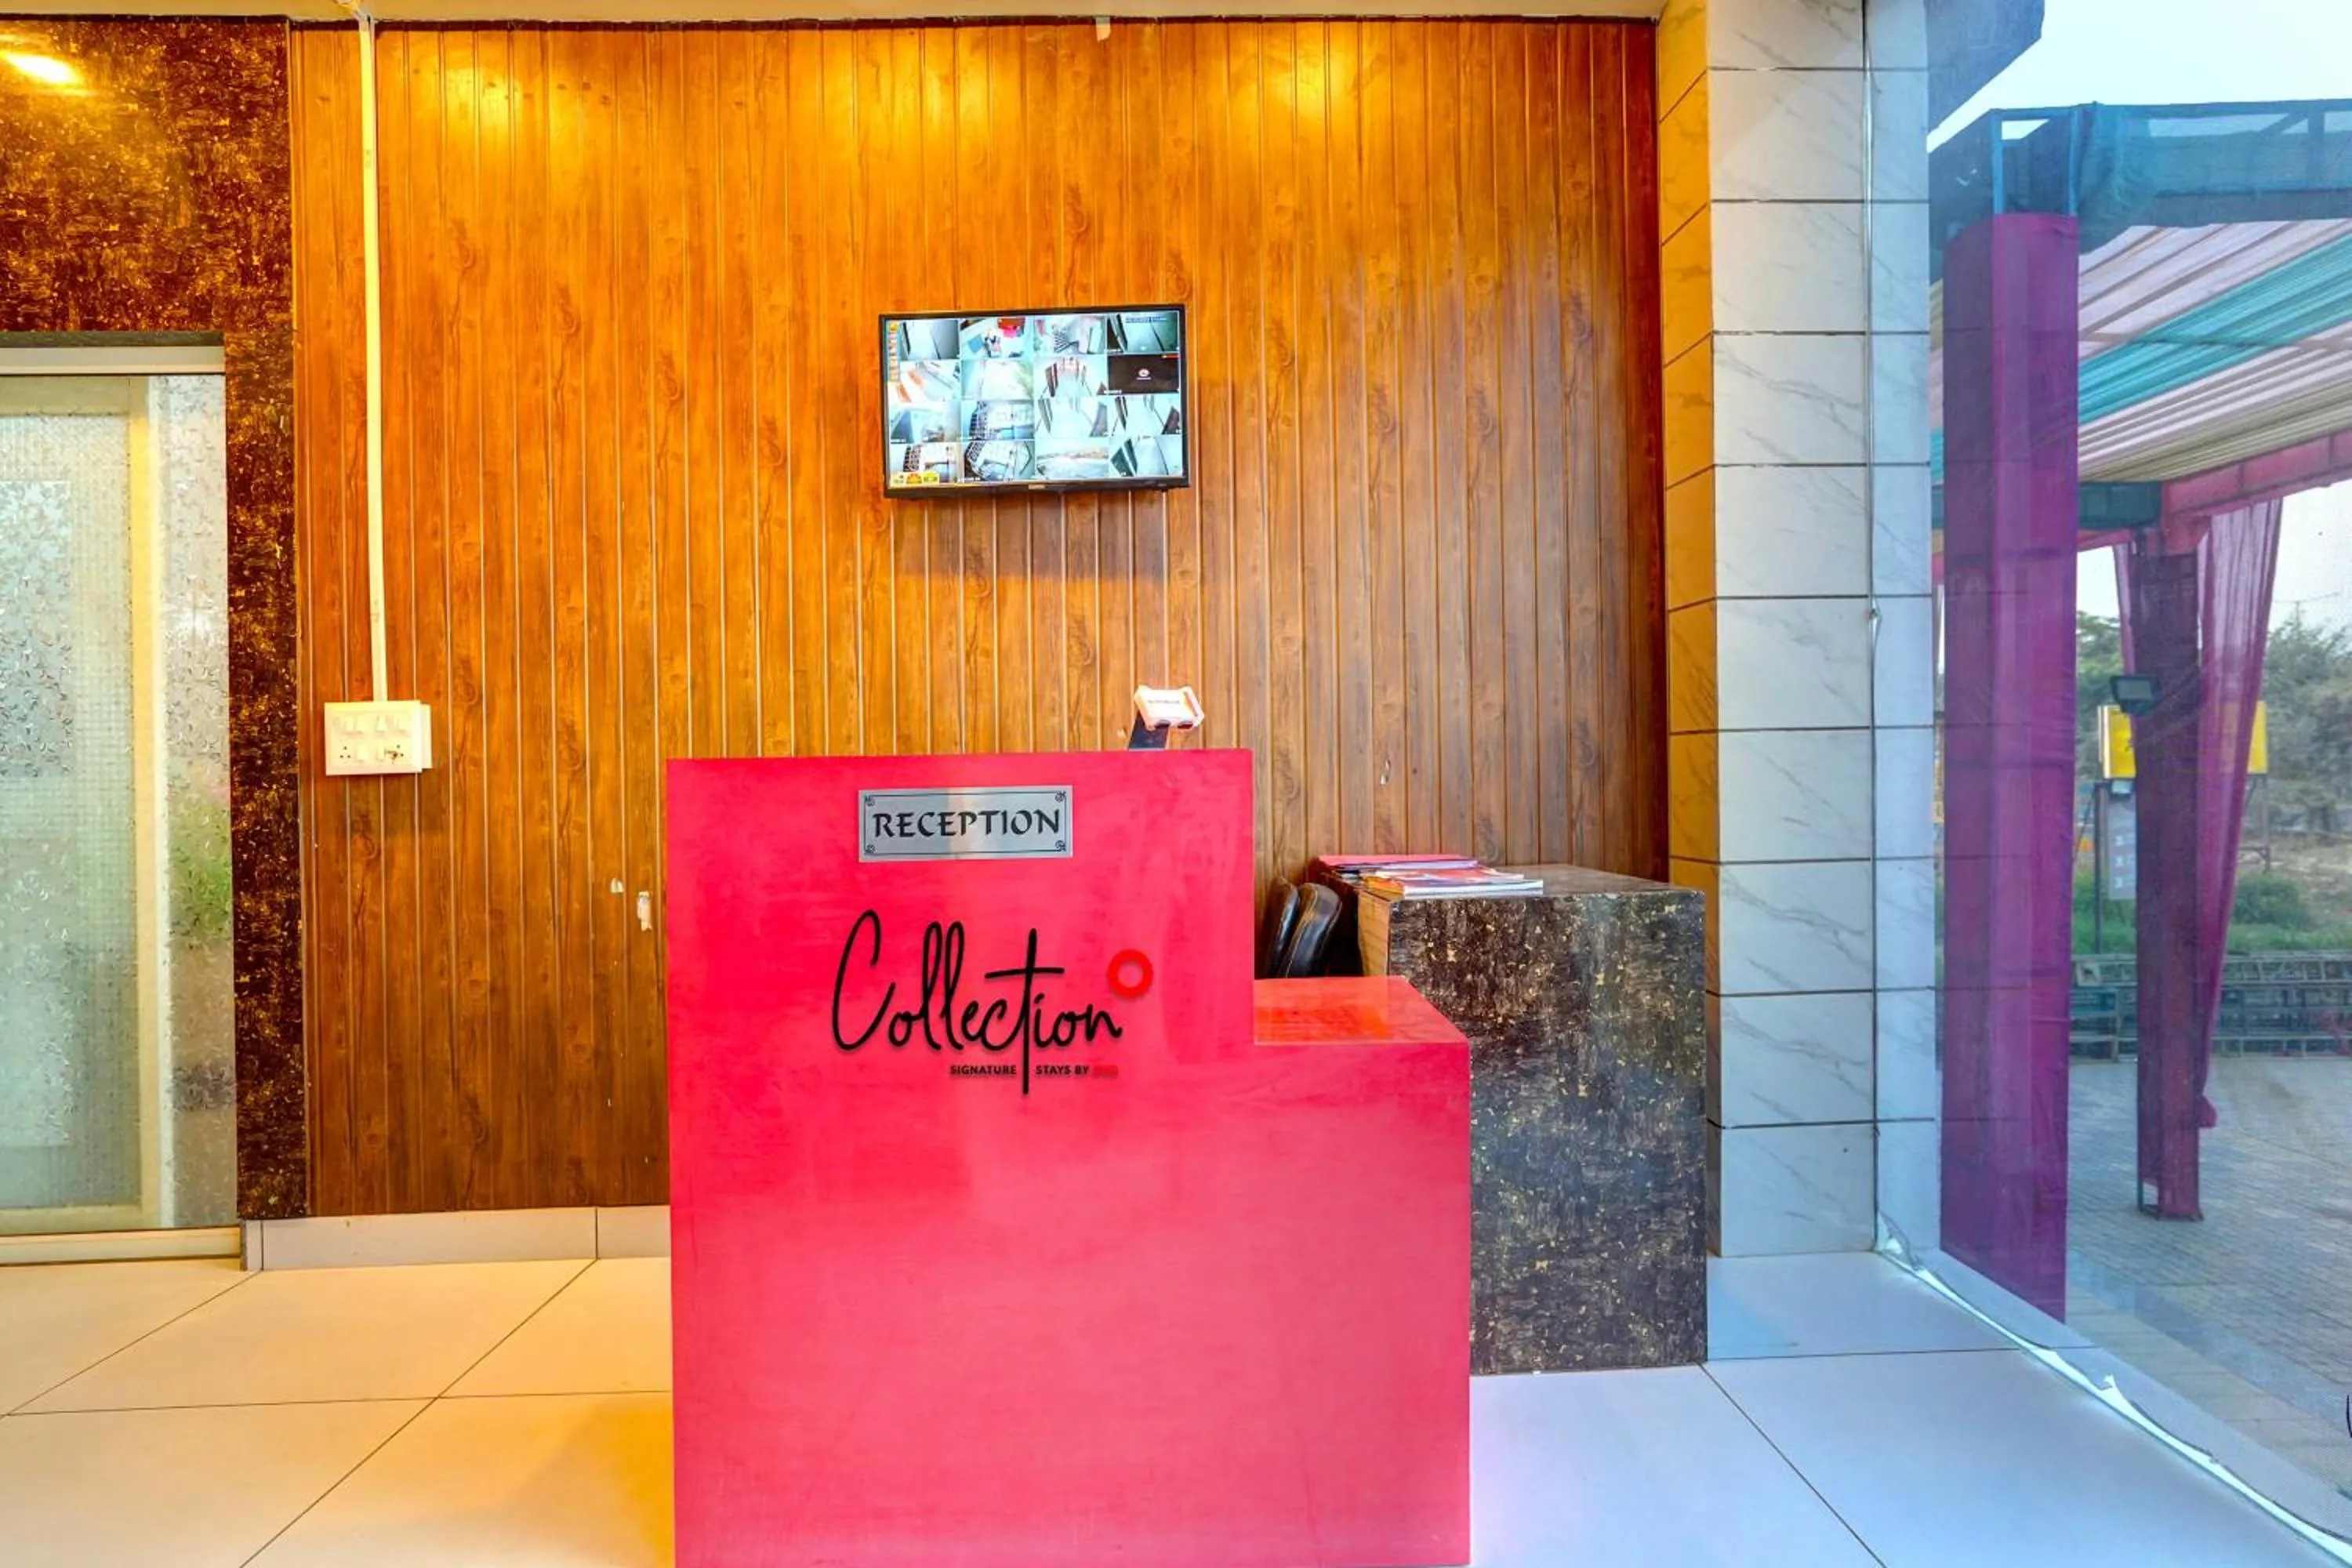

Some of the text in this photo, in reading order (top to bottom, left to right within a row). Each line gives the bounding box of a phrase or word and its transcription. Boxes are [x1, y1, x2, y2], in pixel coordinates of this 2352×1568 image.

[873, 808, 1060, 838] RECEPTION
[833, 909, 1123, 1094] Collection
[950, 1065, 1017, 1076] SIGNATURE
[1035, 1065, 1072, 1076] STAYS
[1075, 1065, 1089, 1076] BY
